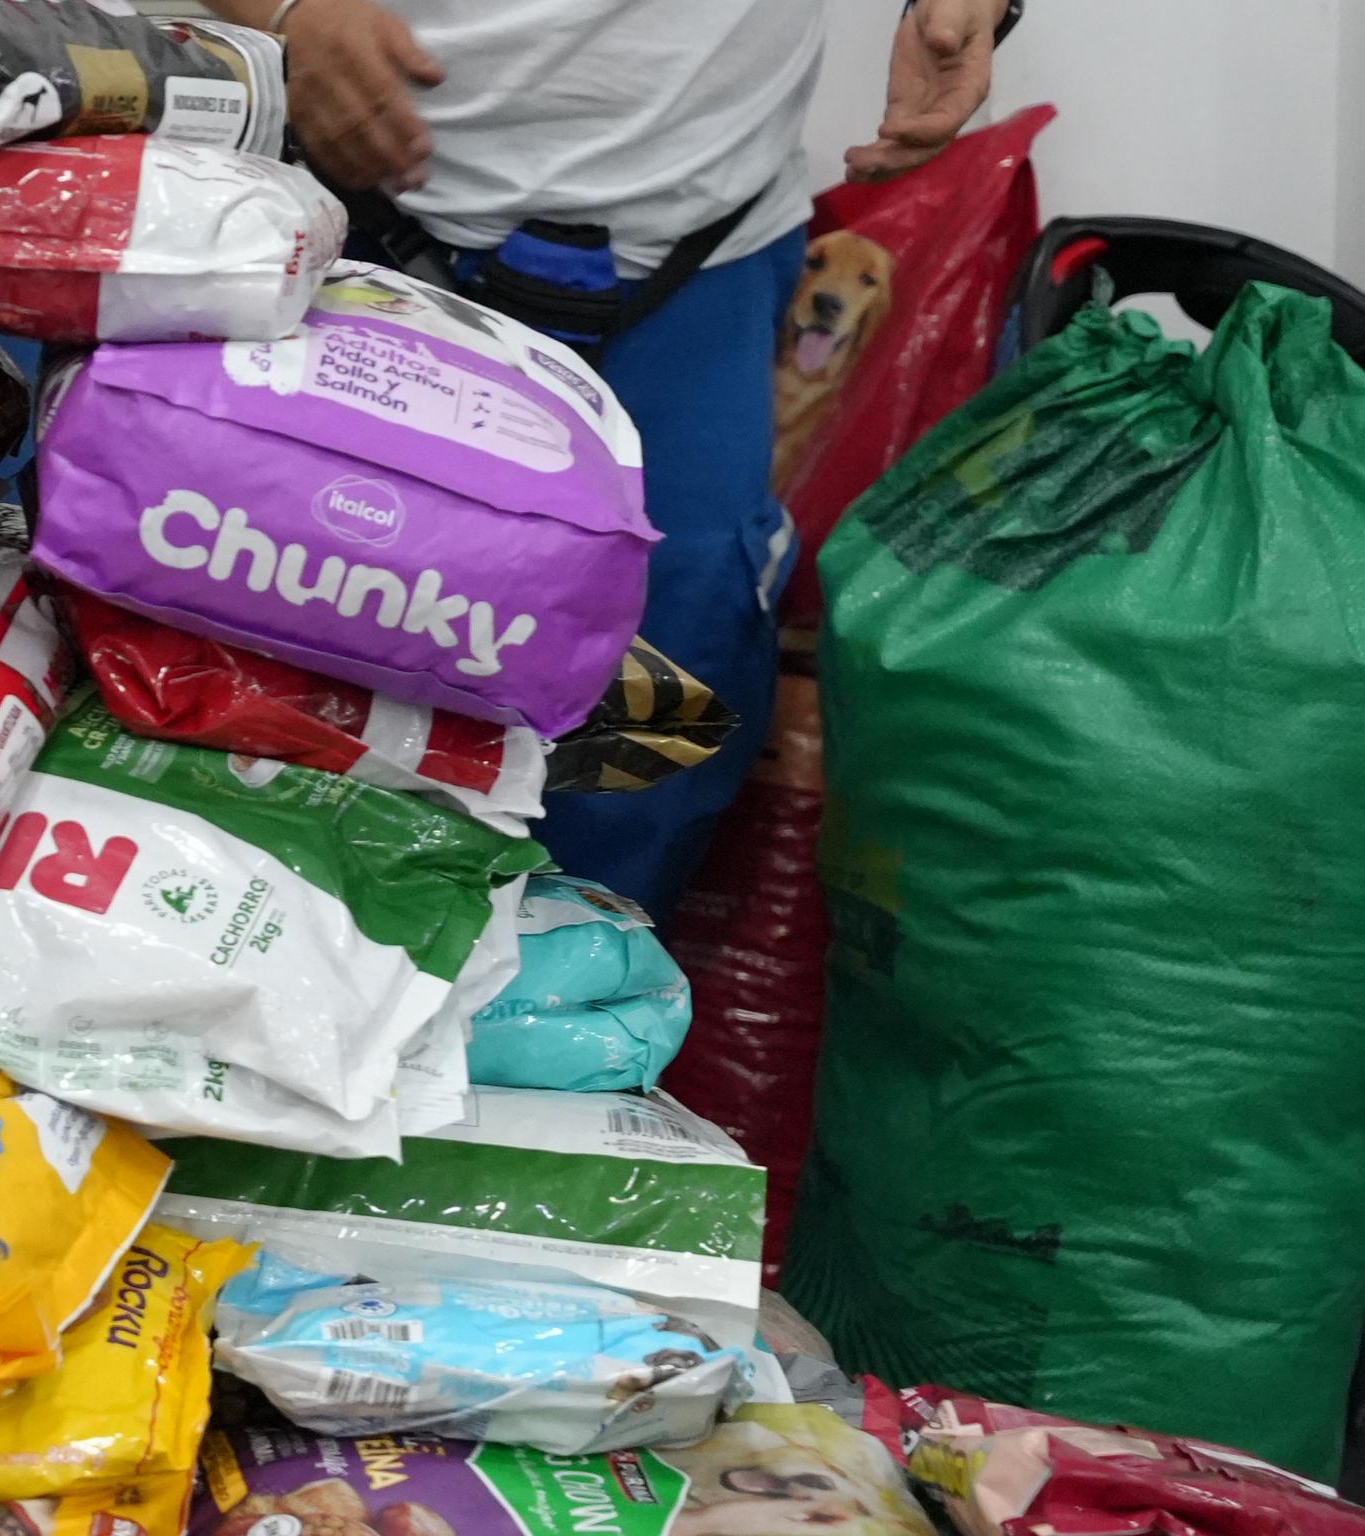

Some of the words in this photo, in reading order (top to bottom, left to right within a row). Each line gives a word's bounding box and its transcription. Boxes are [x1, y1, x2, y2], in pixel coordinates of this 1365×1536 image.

[319, 354, 379, 384] Pollo
[324, 341, 377, 370] Vida
[384, 360, 455, 397] Activa
[325, 332, 441, 378] Adultos
[313, 371, 409, 413] Salmón
[138, 487, 537, 678] Chunky
[248, 921, 283, 955] 2kg
